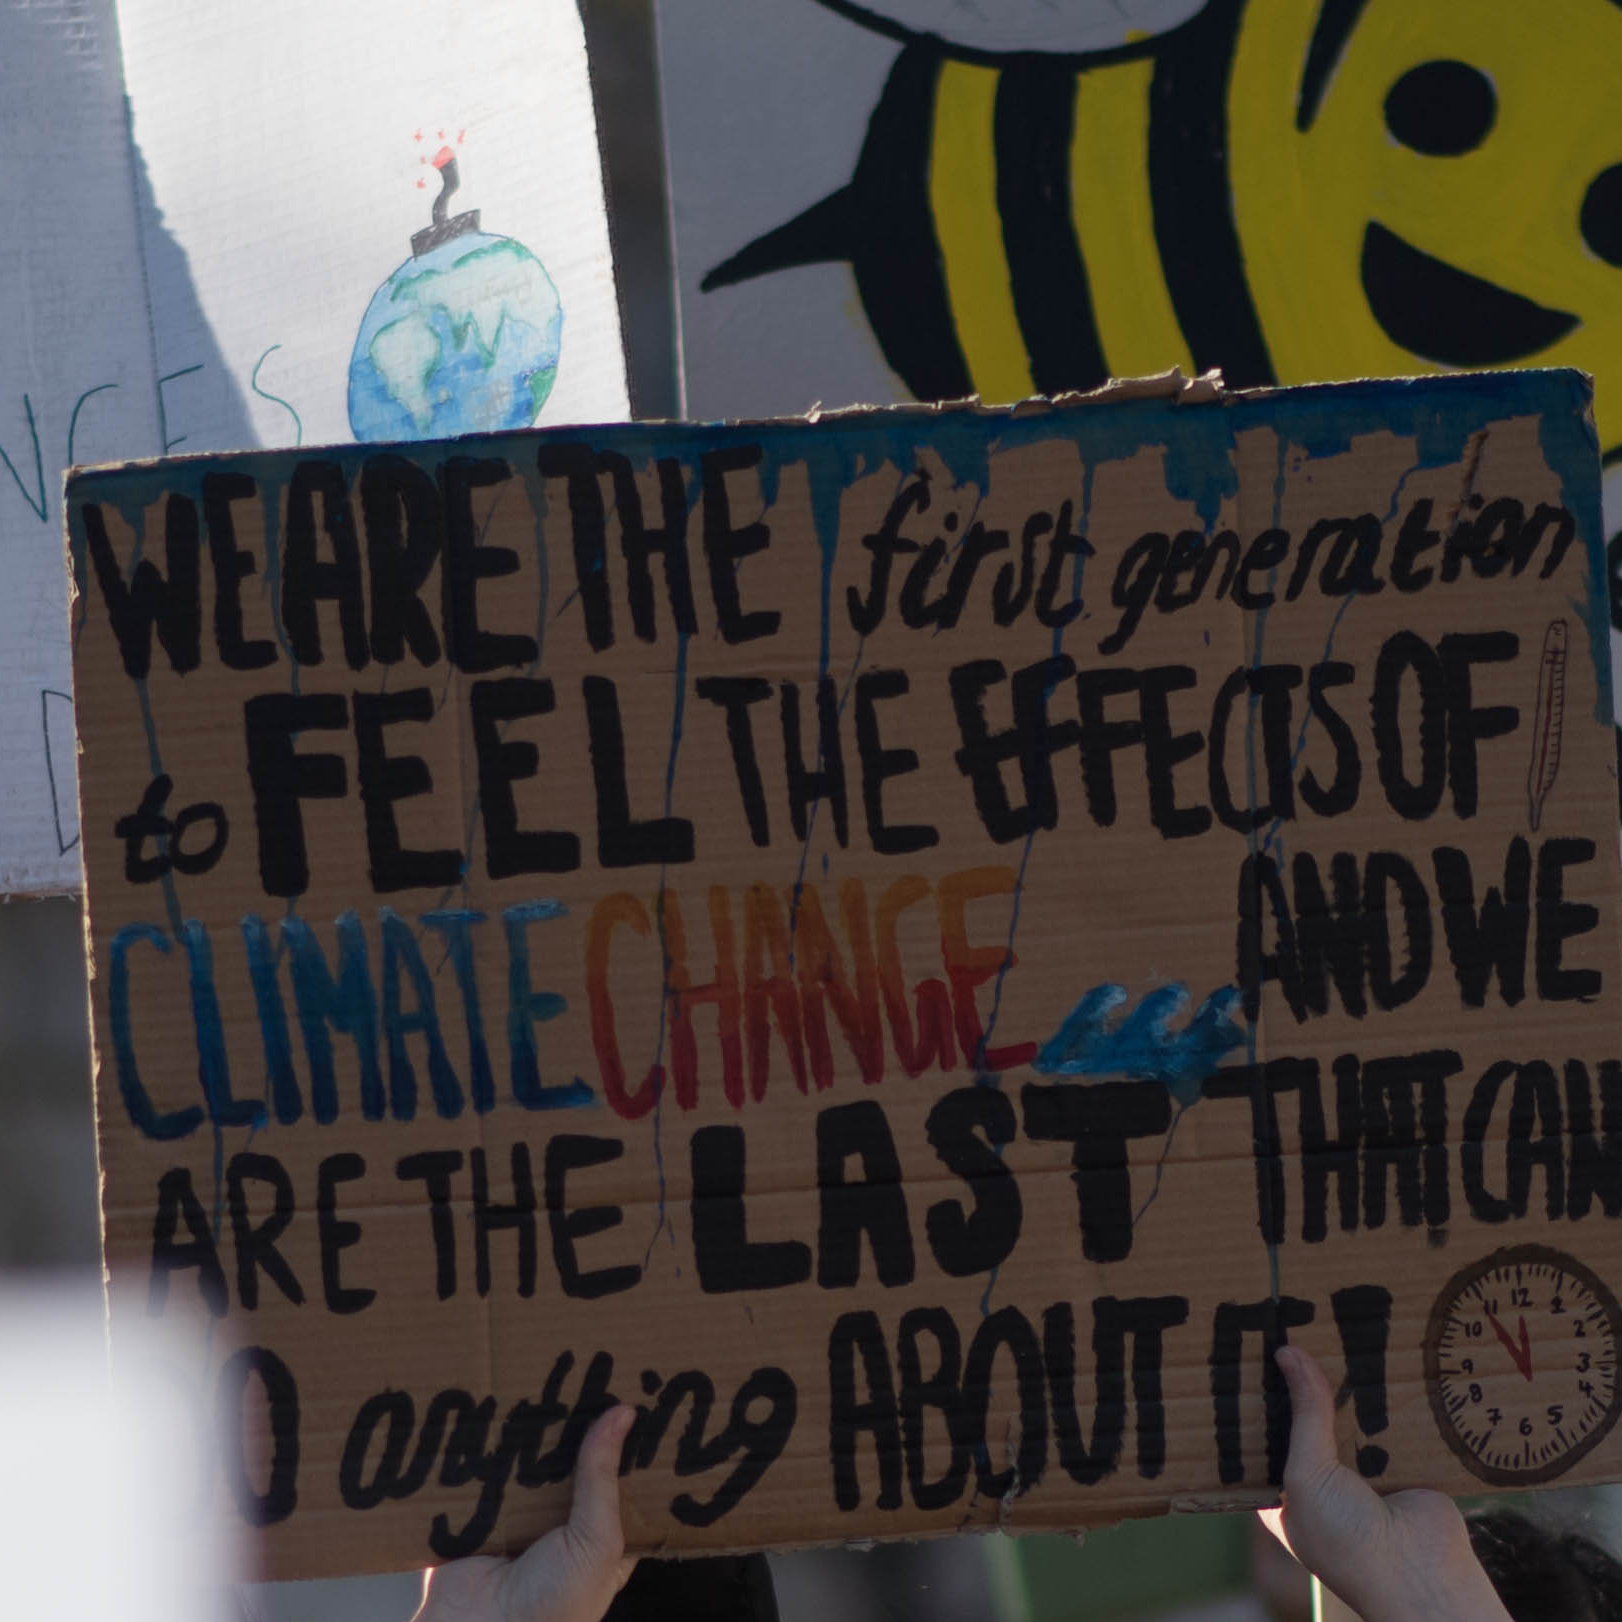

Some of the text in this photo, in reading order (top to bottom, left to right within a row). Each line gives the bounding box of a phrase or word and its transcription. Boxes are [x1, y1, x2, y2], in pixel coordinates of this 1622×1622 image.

[82, 443, 1577, 680] WE ARE THE first generation
[115, 630, 1520, 898] to FEEL THE EFFECTS OF
[108, 836, 1602, 1142] CLIMATE CHANGE AND WE
[145, 1152, 378, 1319] ARE
[395, 1133, 643, 1300] THE
[689, 1080, 1172, 1294] LAST
[1201, 1049, 1463, 1246] THAT
[1511, 1287, 1533, 1308] 12
[1465, 1321, 1483, 1338] 10
[1573, 1319, 1586, 1337] 2
[1461, 1358, 1475, 1375] 9
[1576, 1352, 1592, 1373] 3
[1469, 1383, 1483, 1404] 8
[1578, 1380, 1595, 1399] 4
[1486, 1408, 1503, 1427] 7
[1519, 1416, 1532, 1436] 6
[1547, 1405, 1564, 1426] 5
[216, 1346, 300, 1529] O
[339, 1350, 797, 1559] anything
[826, 1295, 1189, 1513] ABOUT
